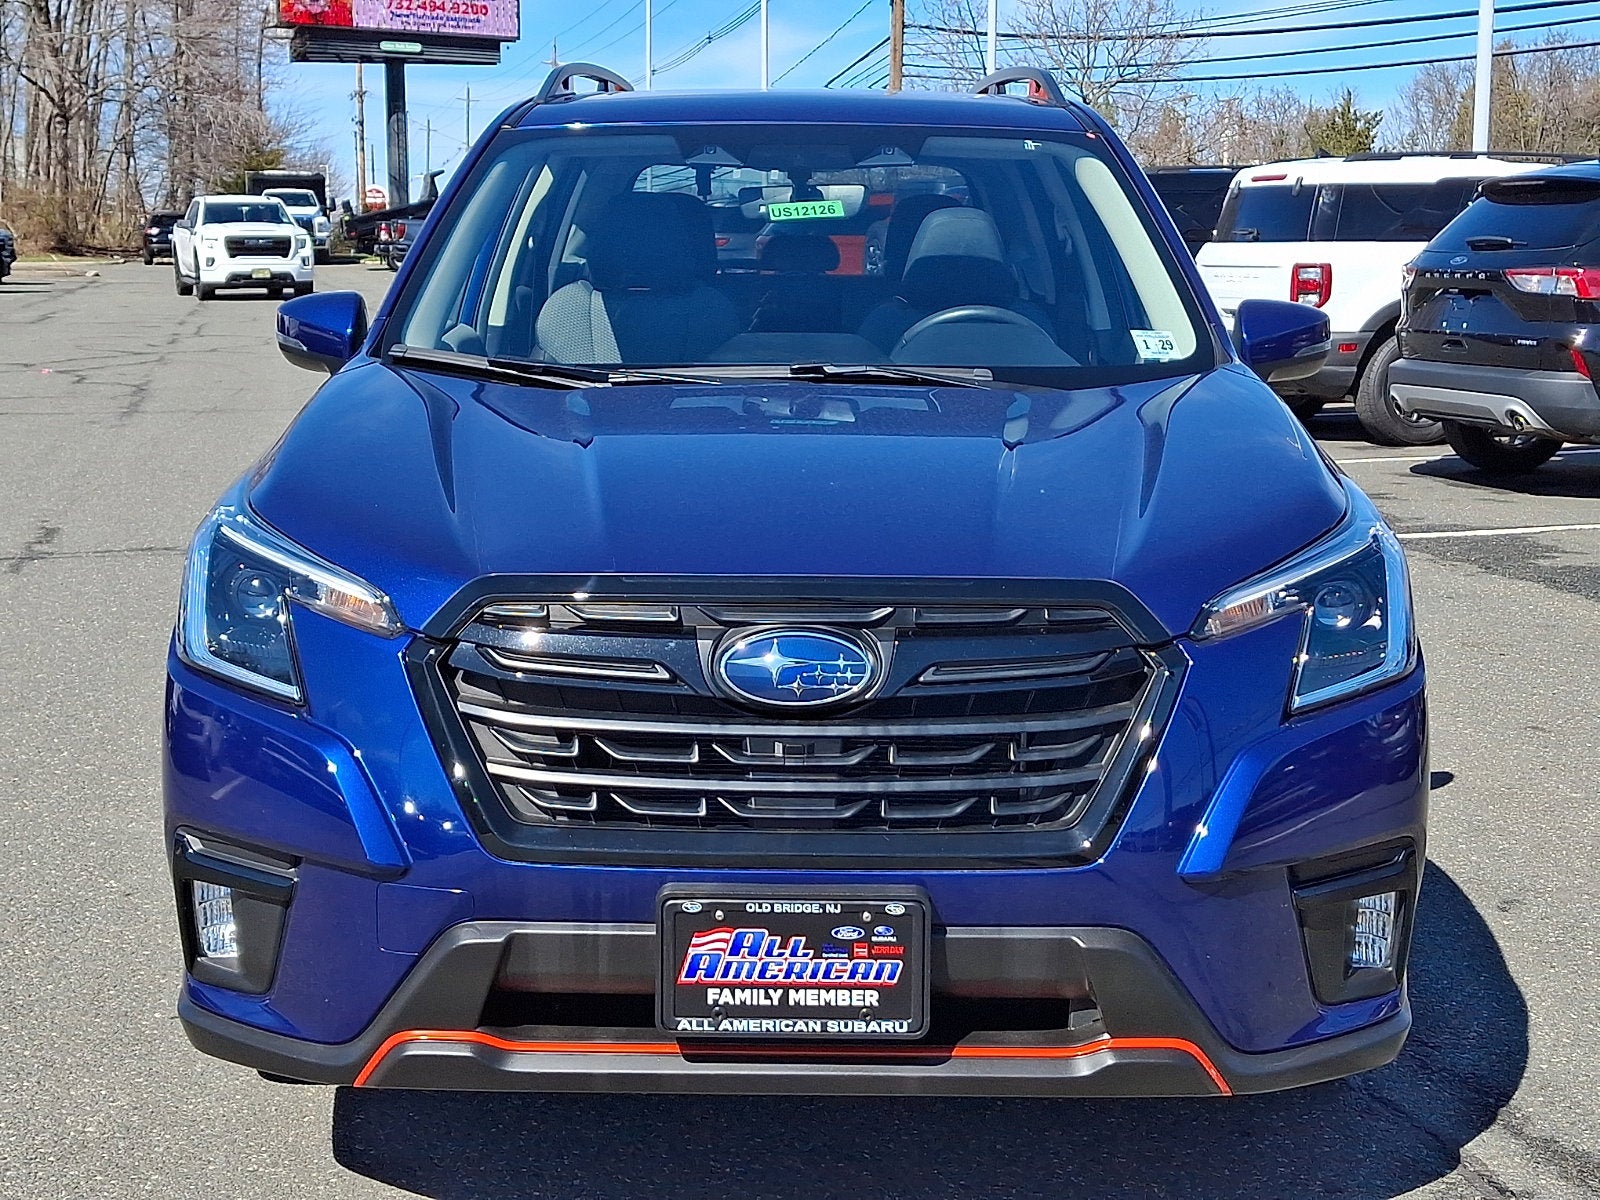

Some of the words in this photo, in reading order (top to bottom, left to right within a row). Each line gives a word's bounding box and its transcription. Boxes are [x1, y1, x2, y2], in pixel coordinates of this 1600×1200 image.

[771, 204, 836, 218] US12126
[1143, 340, 1151, 350] 1
[1158, 340, 1174, 350] 29
[745, 903, 771, 913] OLD
[825, 904, 842, 914] NJ
[707, 988, 783, 1006] FAMILY
[788, 989, 879, 1007] MEMBER
[677, 1019, 717, 1031] ALL
[718, 1020, 821, 1032] AMERICAN
[826, 1020, 908, 1033] SUBARU
